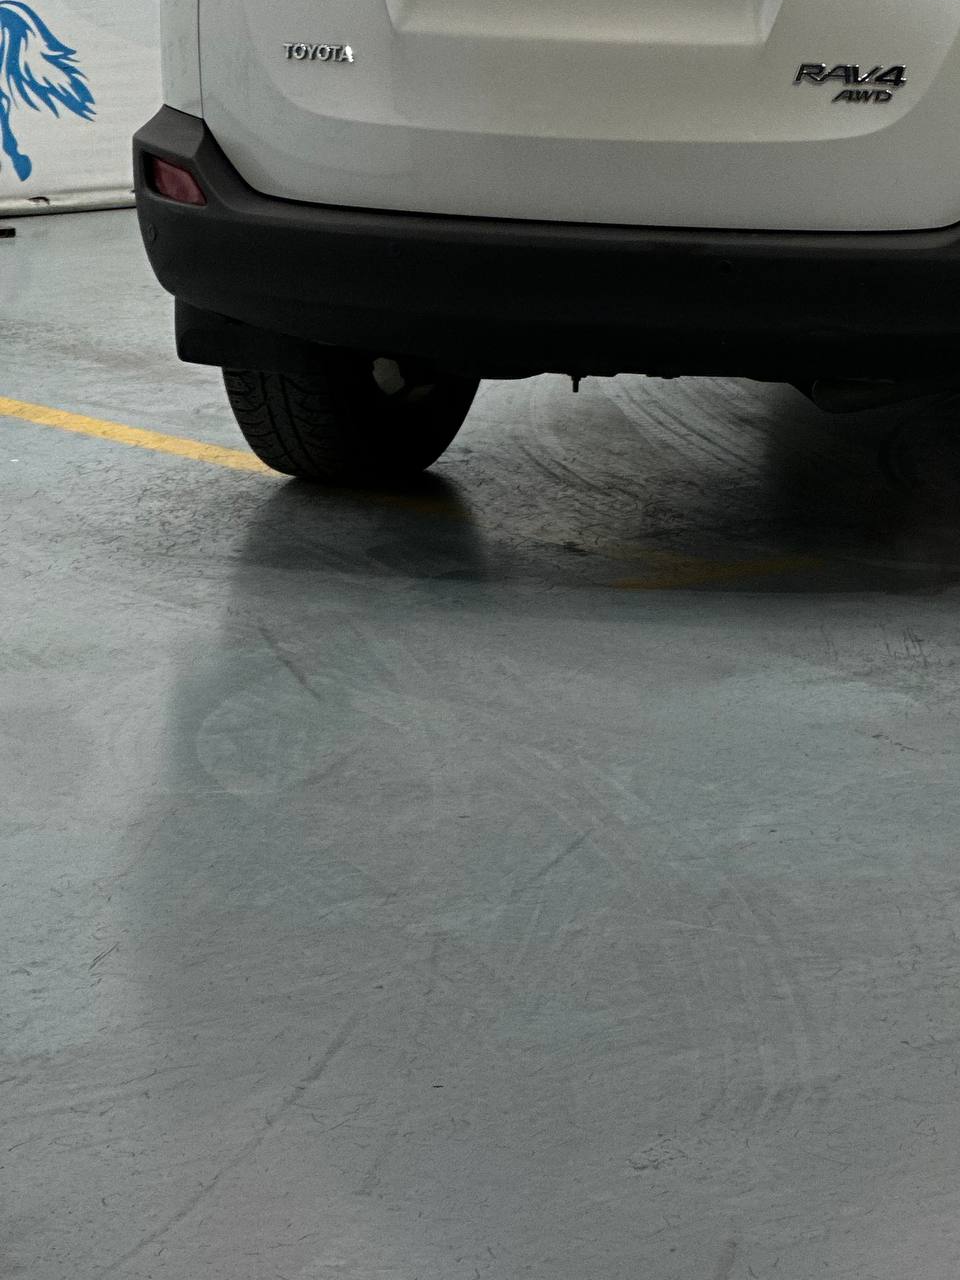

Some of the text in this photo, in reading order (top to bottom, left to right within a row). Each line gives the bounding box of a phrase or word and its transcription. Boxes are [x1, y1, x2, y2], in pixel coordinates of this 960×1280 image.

[283, 43, 354, 63] TOYOTA
[794, 63, 906, 86] RAV4
[831, 89, 893, 104] AWD
